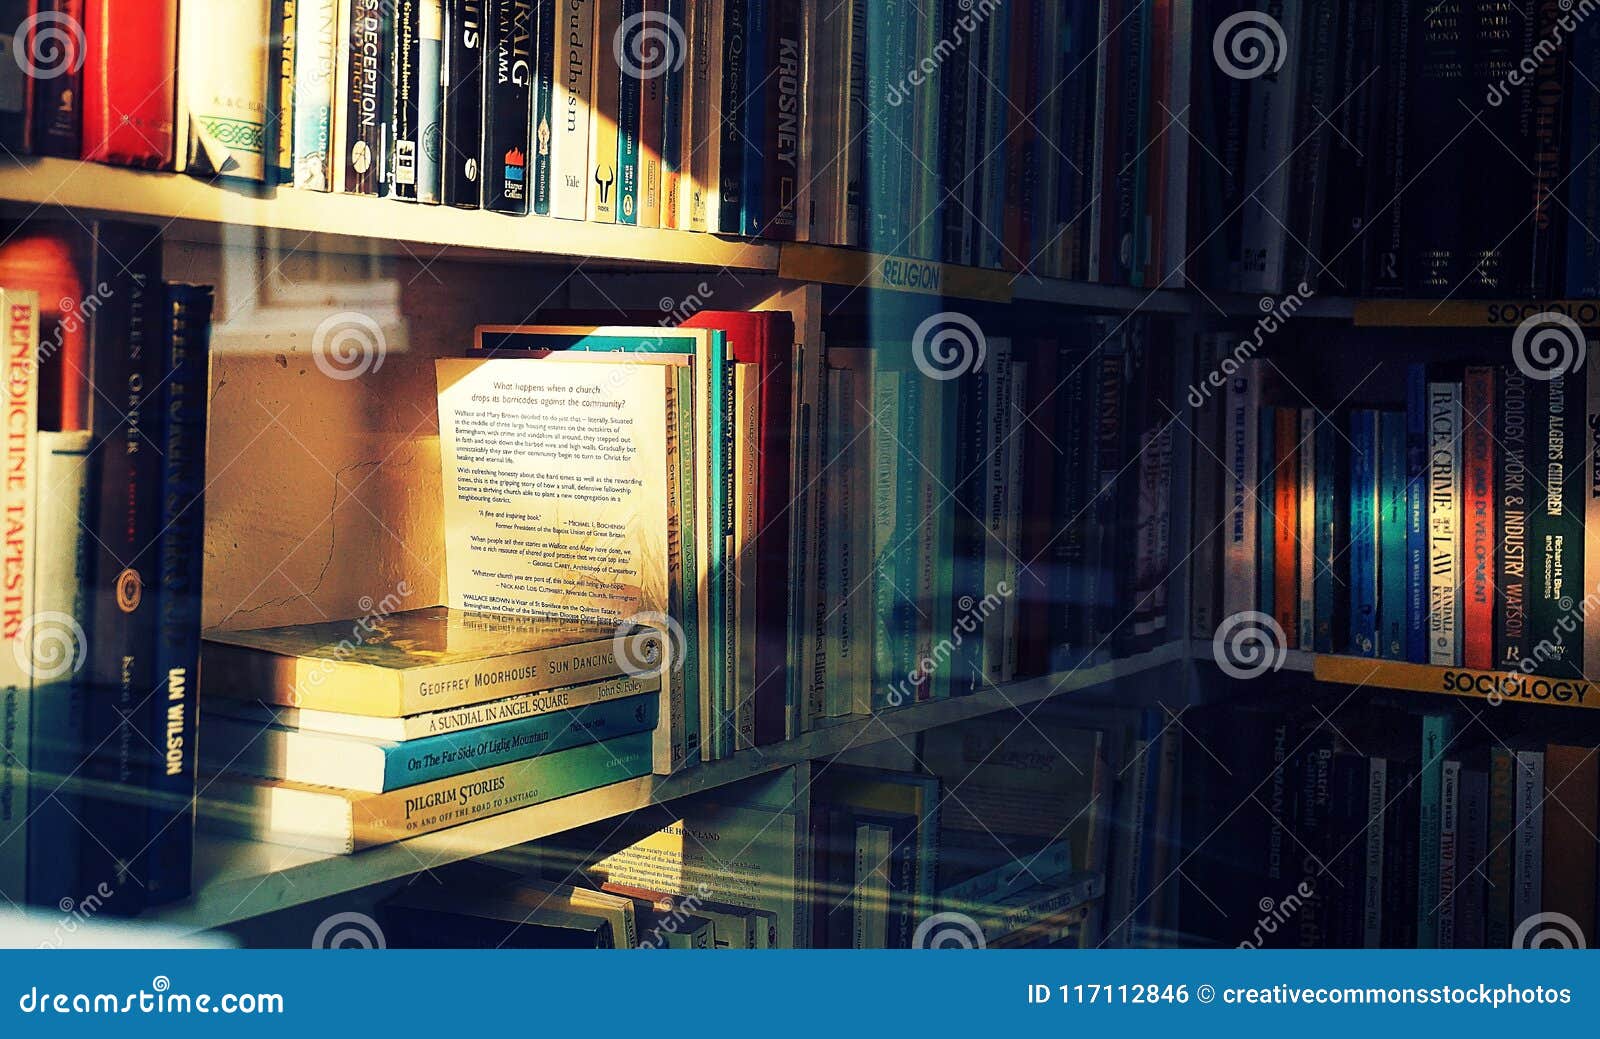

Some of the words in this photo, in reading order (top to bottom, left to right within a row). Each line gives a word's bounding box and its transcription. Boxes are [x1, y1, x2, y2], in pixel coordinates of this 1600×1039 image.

[361, 17, 378, 127] DECEPTION
[777, 36, 799, 168] KROSNEY
[319, 105, 328, 161] OXFORD
[565, 174, 581, 188] Yale
[883, 259, 940, 291] RELIGION
[726, 366, 734, 386] The
[997, 352, 1007, 373] The
[8, 303, 32, 490] BENEDICTINE
[471, 394, 490, 404] drops
[492, 395, 500, 403] its
[502, 395, 538, 405] barricades
[541, 397, 566, 408] against
[568, 397, 579, 406] the
[581, 399, 626, 411] community?
[493, 382, 513, 391] What
[515, 383, 545, 393] happens
[547, 384, 566, 393] when
[576, 385, 601, 394] church
[127, 373, 143, 455] ORDER
[666, 387, 677, 455] ANGELS
[726, 389, 734, 437] Ministry
[993, 376, 1006, 467] Transfiguration
[1432, 391, 1453, 444] RACE,
[726, 441, 734, 468] Team
[1548, 415, 1566, 460] ALGER'S
[670, 464, 676, 478] ON
[1432, 450, 1453, 512] CRIME,
[1504, 449, 1525, 491] WORK
[1547, 463, 1565, 516] CHILDREN
[726, 473, 734, 530] Handbook
[992, 485, 1003, 530] Politics
[1504, 495, 1524, 507] &
[668, 514, 680, 572] WALLS
[1432, 537, 1453, 578] LAW
[1473, 500, 1488, 604] DEVELOPMENT
[1503, 509, 1525, 578] INDUSTRY
[1544, 535, 1553, 551] and
[1554, 535, 1563, 568] Richard
[3, 503, 27, 641] TAPESTRY
[1543, 553, 1553, 600] Associates
[1553, 577, 1563, 600] Blum
[816, 602, 826, 650] Charles
[1432, 585, 1442, 632] KENNEDY
[1443, 585, 1452, 632] RANDALL
[1503, 583, 1525, 639] WATSON
[168, 668, 187, 700] IAN
[419, 678, 470, 697] GEOFFREY
[474, 665, 537, 688] MOORHOUSE
[549, 660, 569, 674] SUN
[573, 653, 614, 670] DANCING
[815, 653, 825, 693] Elliott
[1443, 671, 1590, 703] SOCIOLOGY
[430, 720, 437, 732] A
[439, 710, 485, 731] SUNDIAL
[485, 707, 497, 722] IN
[499, 700, 531, 719] ANGEL
[532, 693, 569, 712] SQUARE
[598, 685, 615, 700] John
[624, 680, 642, 694] Foley
[166, 703, 185, 776] WILSON
[408, 757, 422, 771] On
[424, 754, 439, 768] The
[441, 750, 456, 765] Far
[457, 745, 476, 760] Side
[476, 743, 487, 756] Of
[511, 731, 550, 750] Mountain
[405, 788, 457, 820] PILGRIM
[459, 776, 505, 806] STORIES
[406, 821, 418, 831] ON
[421, 814, 437, 827] AND
[439, 810, 452, 823] OFF
[455, 807, 469, 819] THE
[471, 801, 491, 815] ROAD
[493, 798, 503, 808] TO
[504, 789, 538, 804] SANTIAGO
[1443, 832, 1454, 860] TWO
[1441, 865, 1454, 915] NATIONS
